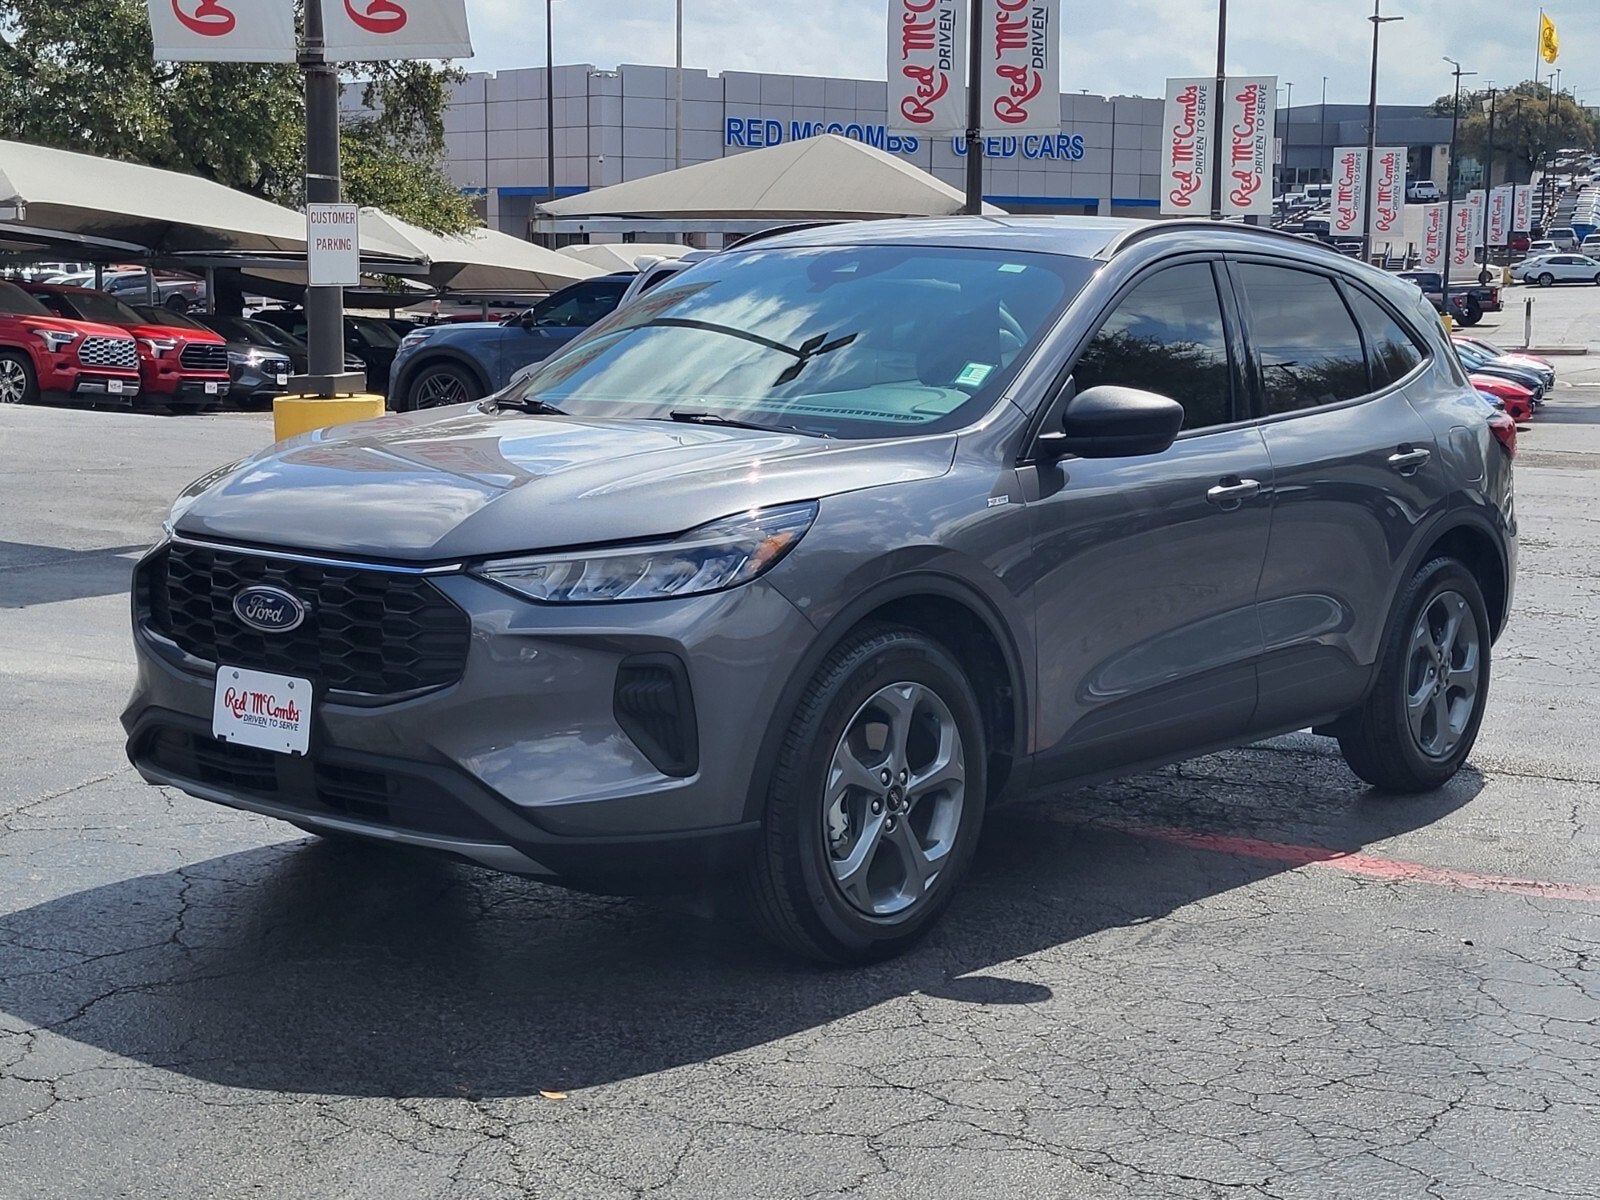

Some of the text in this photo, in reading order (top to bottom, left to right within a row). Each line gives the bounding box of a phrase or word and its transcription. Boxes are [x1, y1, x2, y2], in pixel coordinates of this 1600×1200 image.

[939, 9, 952, 70] DRIVEN
[1032, 7, 1044, 69] DRIVEN
[901, 65, 948, 123] Red
[993, 65, 1041, 123] Red
[726, 117, 783, 148] RED
[954, 136, 1017, 157] UED
[1023, 134, 1084, 160] CARS
[1169, 86, 1201, 207] Red McCombs
[1195, 85, 1207, 175] DRIVEN TO SERVE
[1230, 85, 1261, 207] Red McCombs
[1255, 84, 1267, 174] DRIVEN TO SERVE
[1335, 153, 1357, 230] Red McCombs
[1354, 174, 1360, 184] TO
[1375, 152, 1397, 231] Red McCombs
[1393, 174, 1400, 184] TO
[310, 211, 356, 224] CUSTOMER
[316, 238, 352, 250] PARKING
[246, 594, 284, 623] Ford
[224, 687, 299, 722] Red McCombs
[243, 713, 299, 732] DRIVEN TO SERVE
